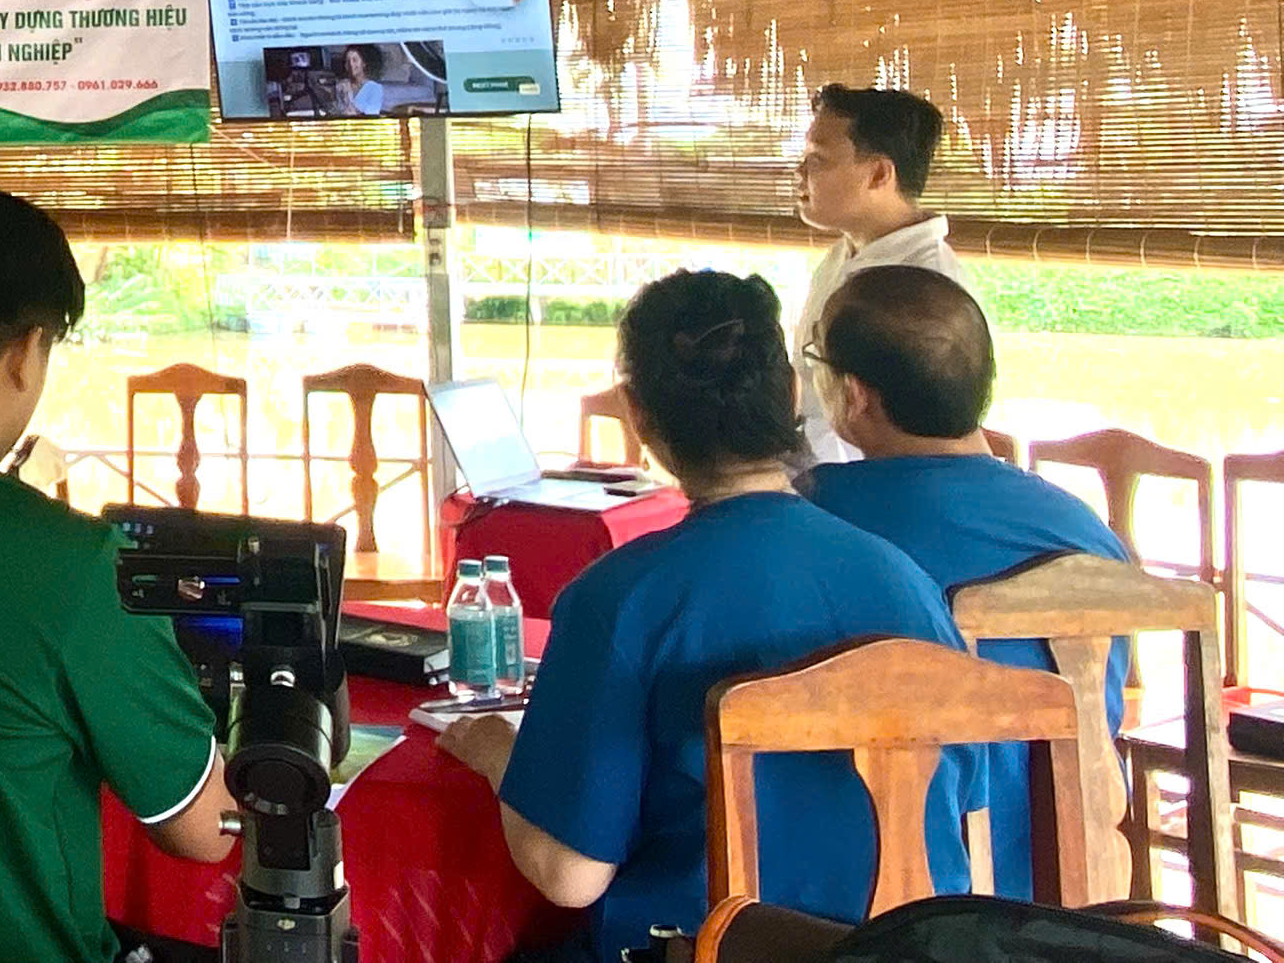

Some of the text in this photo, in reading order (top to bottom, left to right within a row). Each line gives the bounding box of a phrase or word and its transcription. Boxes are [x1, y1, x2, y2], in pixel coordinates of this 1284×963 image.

[14, 9, 63, 33] DỰNG
[70, 7, 140, 29] THƯƠNG
[146, 4, 188, 31] HIỆU
